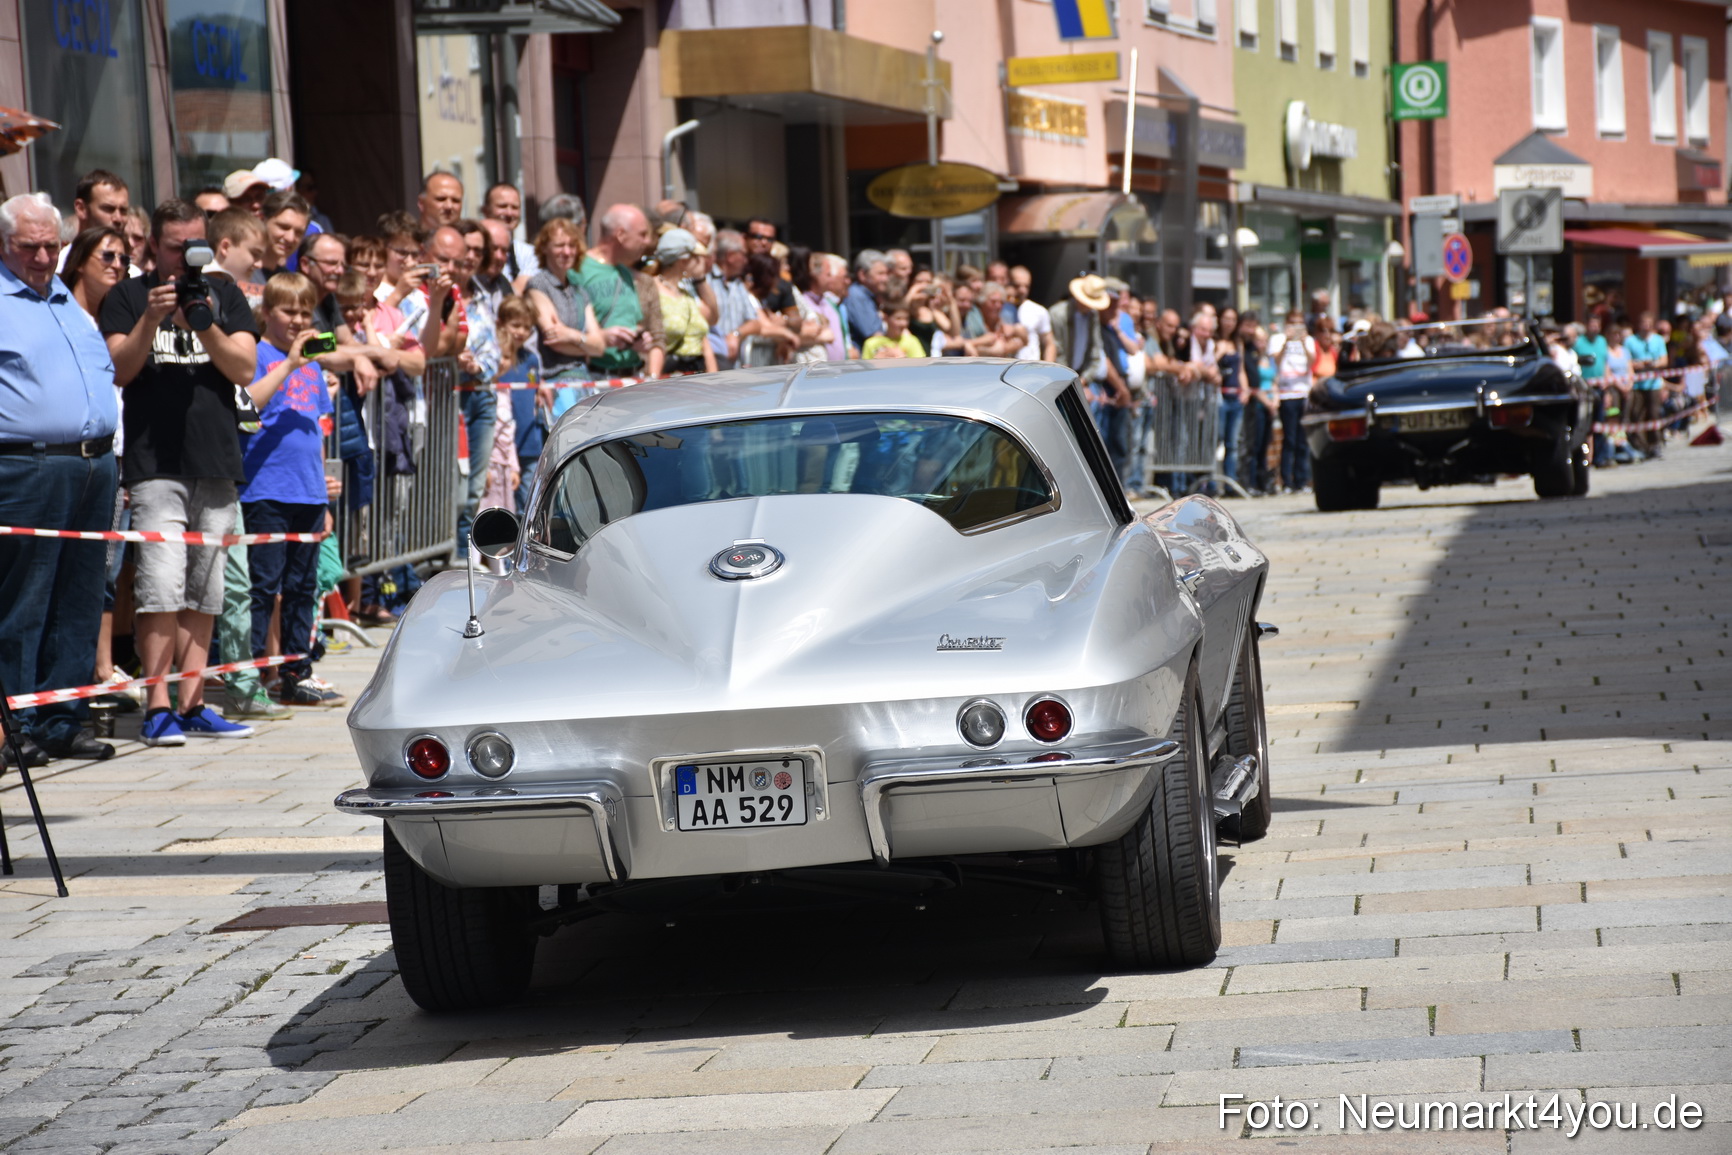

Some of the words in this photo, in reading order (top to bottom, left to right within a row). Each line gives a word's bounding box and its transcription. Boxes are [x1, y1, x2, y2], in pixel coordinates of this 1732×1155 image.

[53, 0, 118, 58] CECIL
[192, 19, 248, 82] CECIL
[937, 633, 1007, 650] Corvette
[683, 784, 691, 794] D
[707, 766, 745, 794] NM
[692, 799, 729, 826] AA
[739, 794, 794, 824] 529
